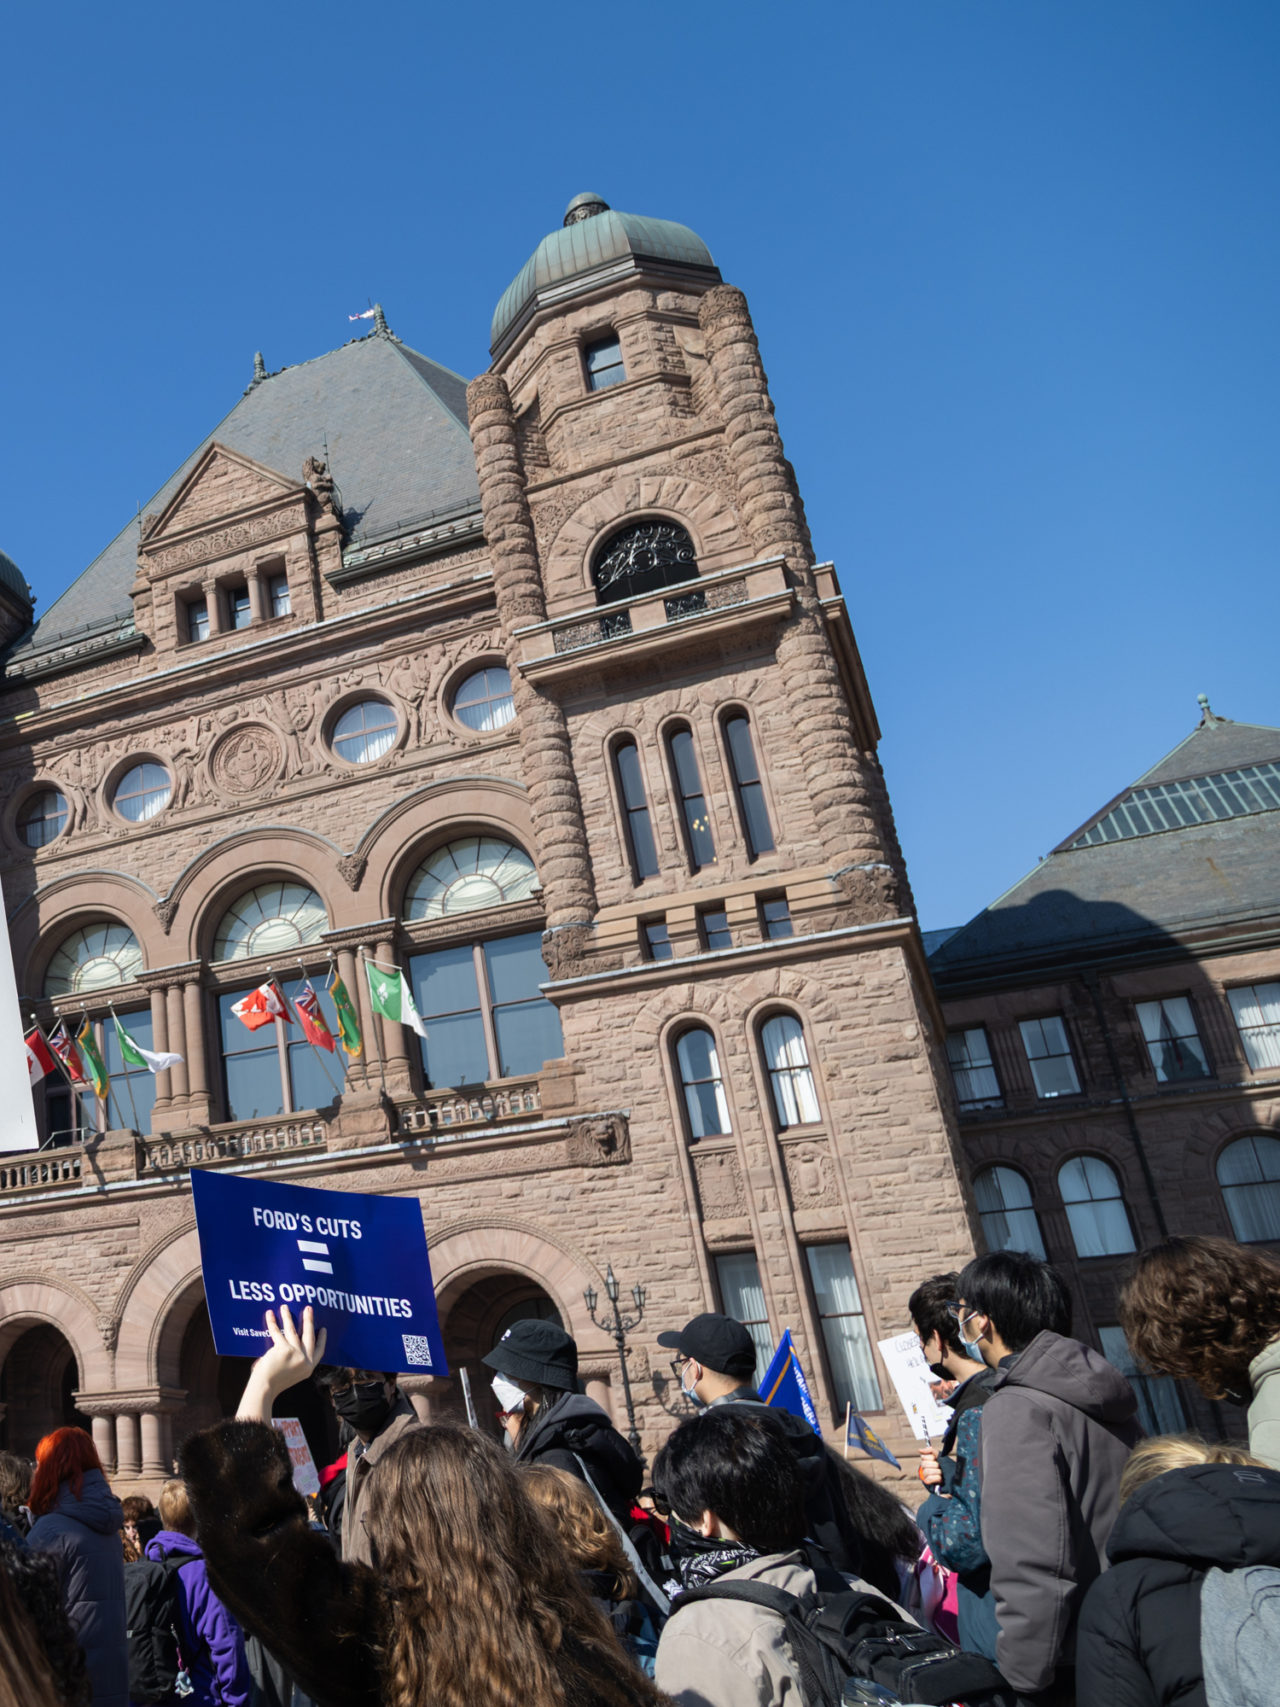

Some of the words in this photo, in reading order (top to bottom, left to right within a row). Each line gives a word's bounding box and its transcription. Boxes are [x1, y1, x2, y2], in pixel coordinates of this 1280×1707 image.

[253, 1207, 314, 1233] FORD'S
[316, 1217, 362, 1240] CUTS
[228, 1279, 275, 1303] LESS
[279, 1283, 413, 1319] OPPORTUNITIES
[232, 1327, 250, 1337] Visit
